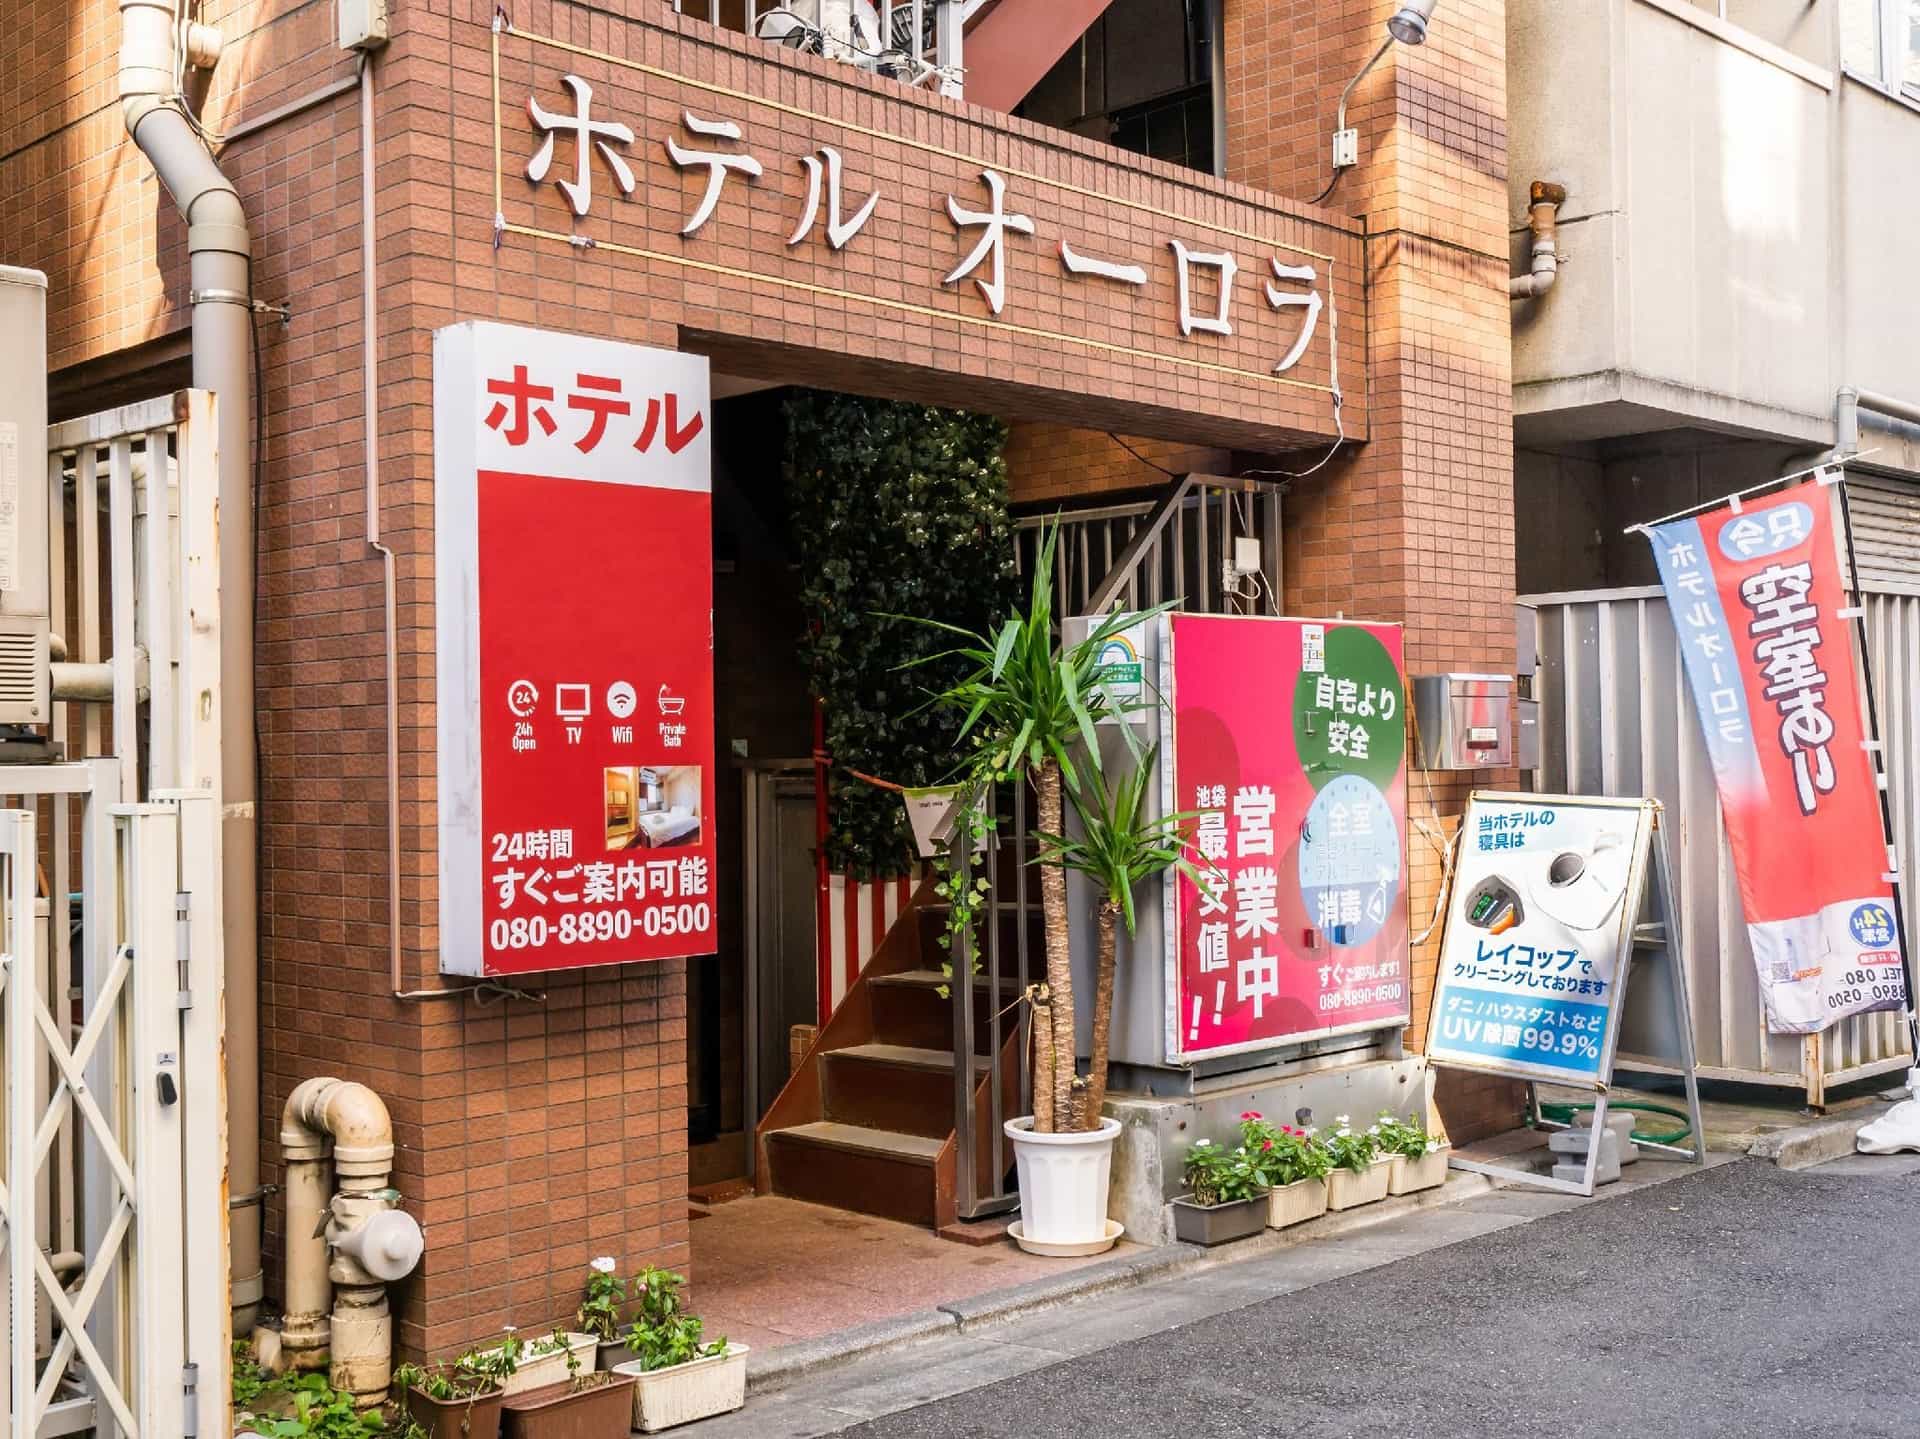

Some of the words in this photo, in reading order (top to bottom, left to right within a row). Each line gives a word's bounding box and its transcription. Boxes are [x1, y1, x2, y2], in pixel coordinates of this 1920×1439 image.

[525, 74, 881, 250] ホテル
[943, 168, 1324, 374] オーロラ
[484, 364, 705, 455] ホテル
[1314, 673, 1396, 721] 自宅より
[512, 736, 536, 752] Open
[514, 722, 533, 737] 24h
[566, 727, 582, 744] TV
[612, 726, 633, 744] Wifi
[659, 722, 686, 735] Private
[1327, 720, 1370, 760] 安全
[1196, 784, 1227, 808] 池袋
[1478, 809, 1555, 833] 当ホテルの
[491, 828, 573, 862] 24時間
[1478, 832, 1525, 851] 寝具は
[492, 855, 708, 910] すぐご案内可能
[1233, 785, 1279, 1018] 営業中
[1317, 889, 1362, 926] 消毒
[490, 902, 710, 950] 080-8890-0500
[1454, 962, 1608, 996] クリーニングしております
[1319, 982, 1401, 1011] 080-8890-0500
